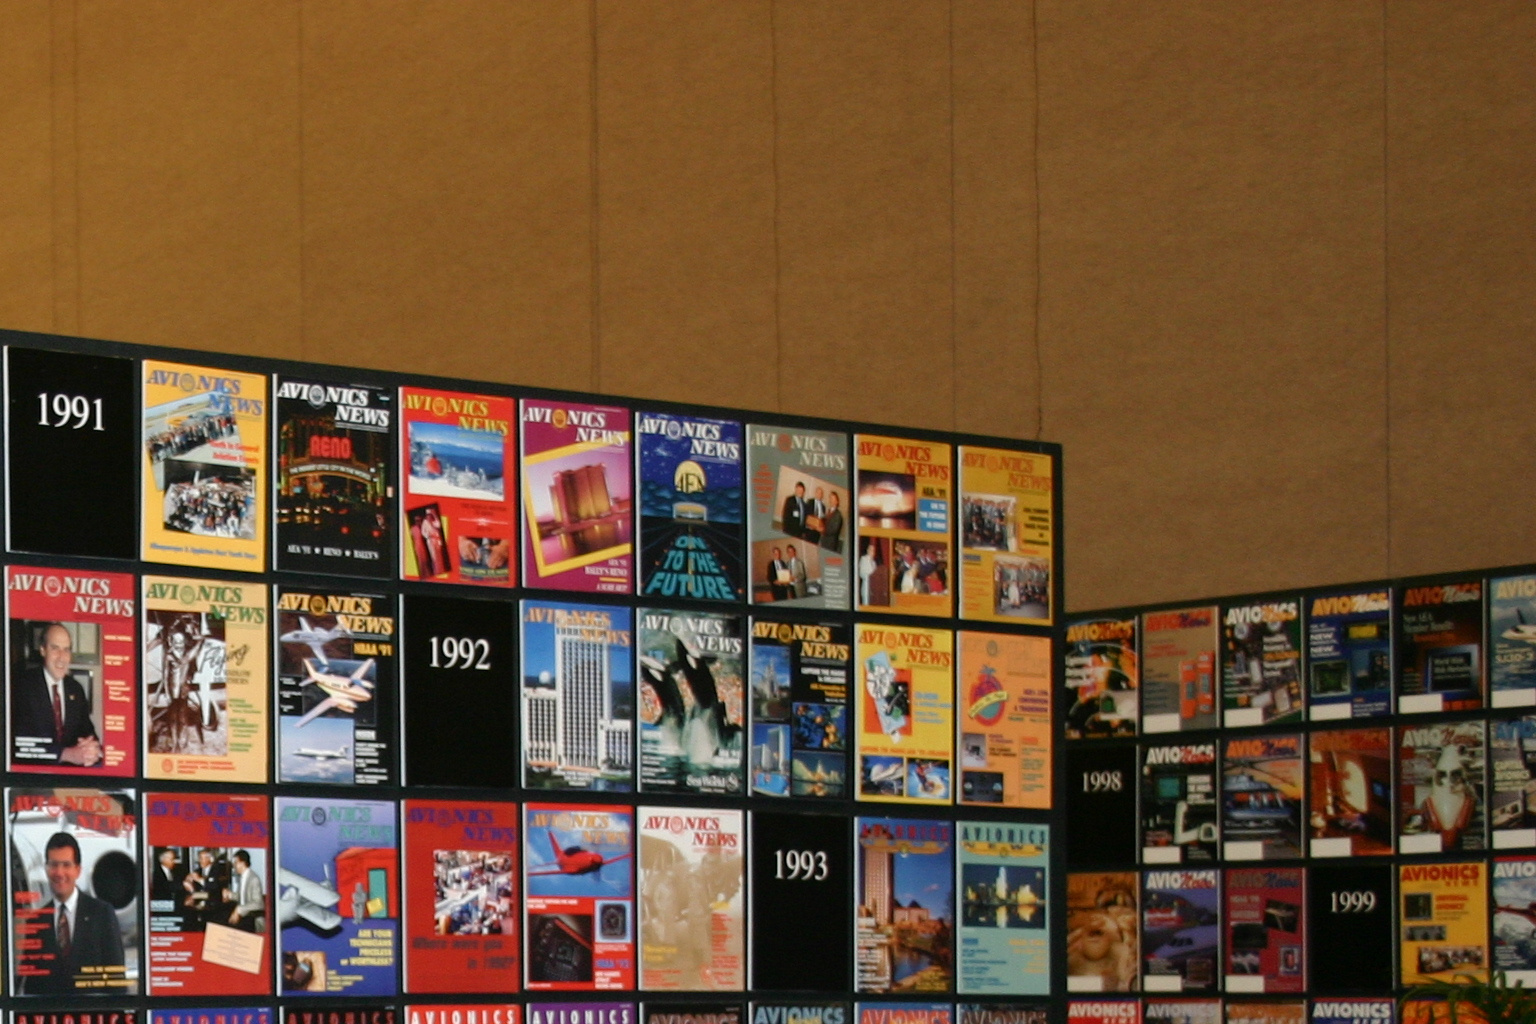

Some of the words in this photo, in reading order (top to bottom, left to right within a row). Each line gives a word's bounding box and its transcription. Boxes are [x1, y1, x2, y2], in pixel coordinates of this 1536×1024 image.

[146, 369, 241, 394] AVIONICS
[206, 394, 263, 416] NEWS
[277, 381, 369, 409] AVIONICS
[403, 393, 489, 417] AVIONICS
[38, 393, 104, 431] 1991
[335, 405, 390, 428] NEWS
[523, 407, 606, 429] AVIONICS
[458, 416, 509, 437] NEWS
[639, 418, 720, 441] AVIONICS
[310, 435, 352, 459] RENO
[575, 427, 626, 448] NEWS
[751, 432, 827, 453] AVIONICS
[690, 439, 739, 461] NEWS
[858, 442, 931, 462] AVIONICS
[799, 454, 844, 470] NEWS
[905, 462, 949, 481] NEWS
[1008, 473, 1052, 491] NEWS
[675, 536, 706, 550] ON
[664, 551, 684, 569] TO
[688, 551, 719, 573] THE
[8, 574, 110, 597] AVIONICS
[146, 583, 242, 605] AVIONICS
[645, 573, 736, 600] FUTURE
[73, 596, 134, 618] NEWS
[209, 605, 264, 624] NEWS
[277, 593, 372, 616] AVIONICS
[341, 615, 393, 636] NEWS
[641, 615, 724, 635] AVIONICS
[752, 622, 831, 643] AVIONICS
[695, 636, 742, 653] NEWS
[859, 630, 934, 649] AVIONICS
[429, 636, 491, 670] 1992
[801, 643, 849, 661] NEWS
[906, 650, 950, 667] NEWS
[1083, 771, 1122, 793] 1998
[76, 815, 135, 832] NEWS
[210, 821, 268, 837] NEWS
[338, 825, 393, 843] NEWS
[643, 816, 720, 835] AVIONICS
[462, 827, 514, 842] NEWS
[692, 832, 738, 847] NEWS
[963, 826, 1045, 843] AVIONICS
[774, 849, 829, 881] 1993
[1401, 864, 1479, 882] AVIONICS
[1331, 891, 1376, 913] 1999
[1068, 1003, 1136, 1017] AVIONICS
[1313, 1002, 1390, 1018] AVIONICS
